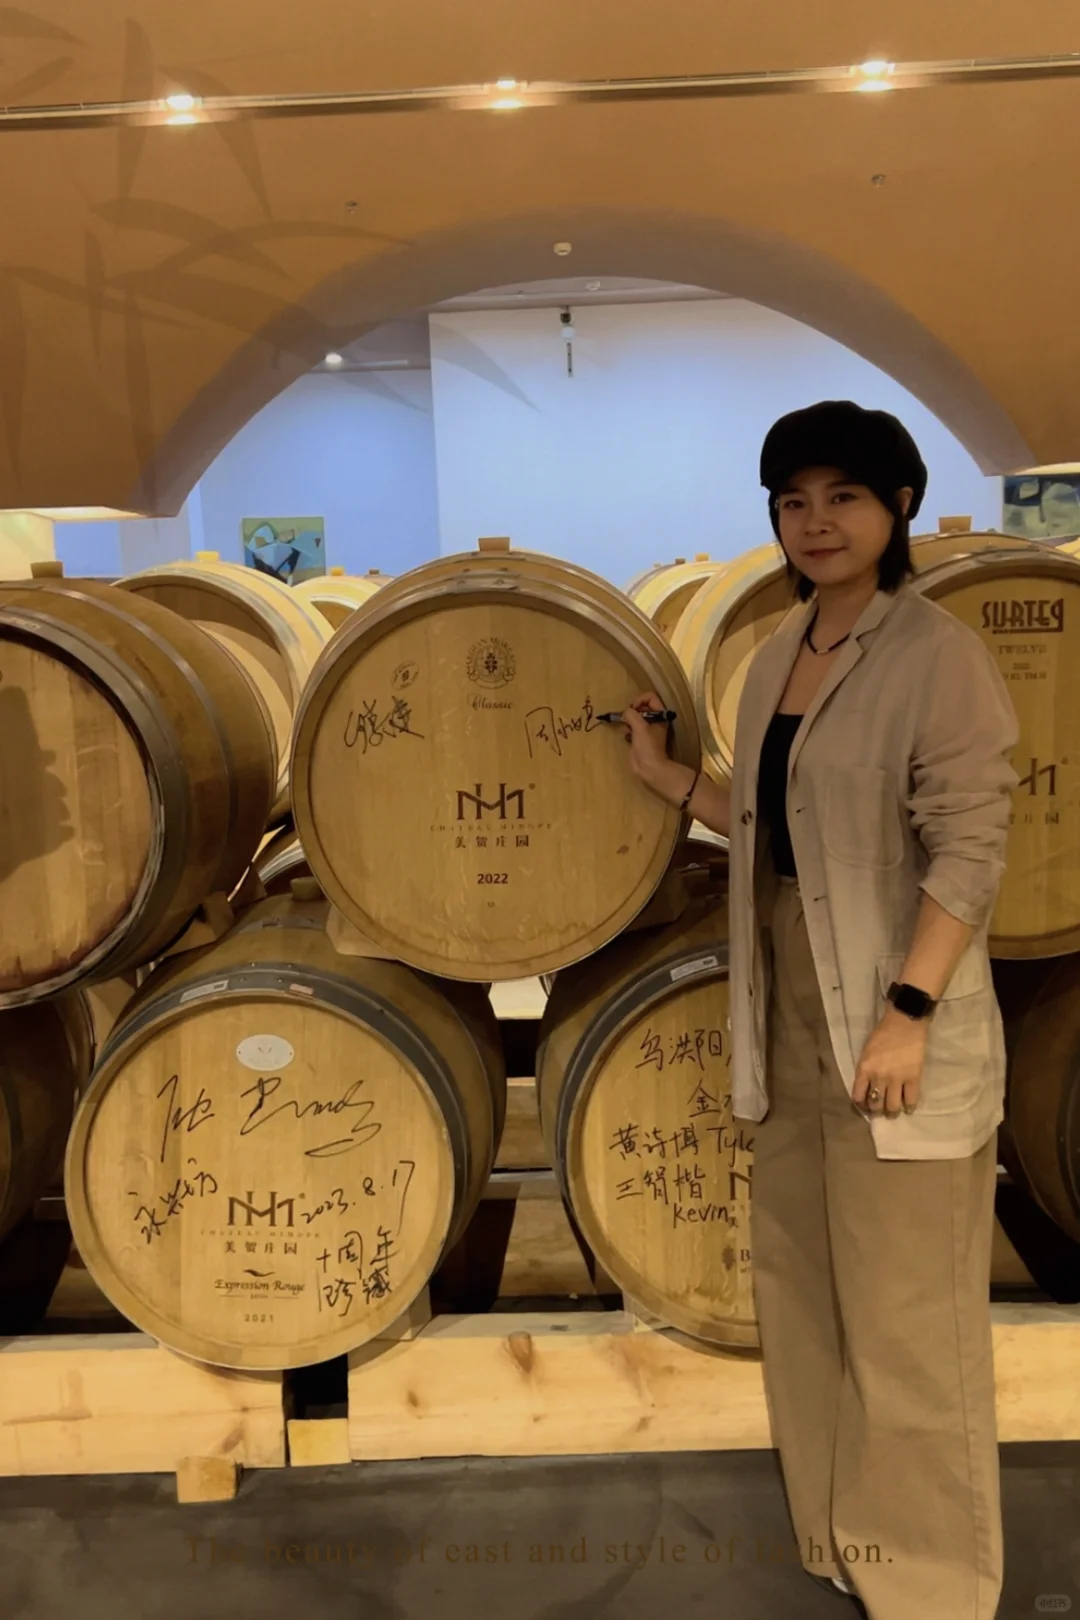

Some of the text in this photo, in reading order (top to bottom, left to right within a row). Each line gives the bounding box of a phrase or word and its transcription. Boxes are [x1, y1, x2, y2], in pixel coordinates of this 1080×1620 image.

[467, 692, 514, 712] Classic
[476, 872, 509, 885] 2022
[213, 1278, 270, 1295] Expression
[272, 1280, 306, 1296] Rouge
[244, 1313, 275, 1324] 2021
